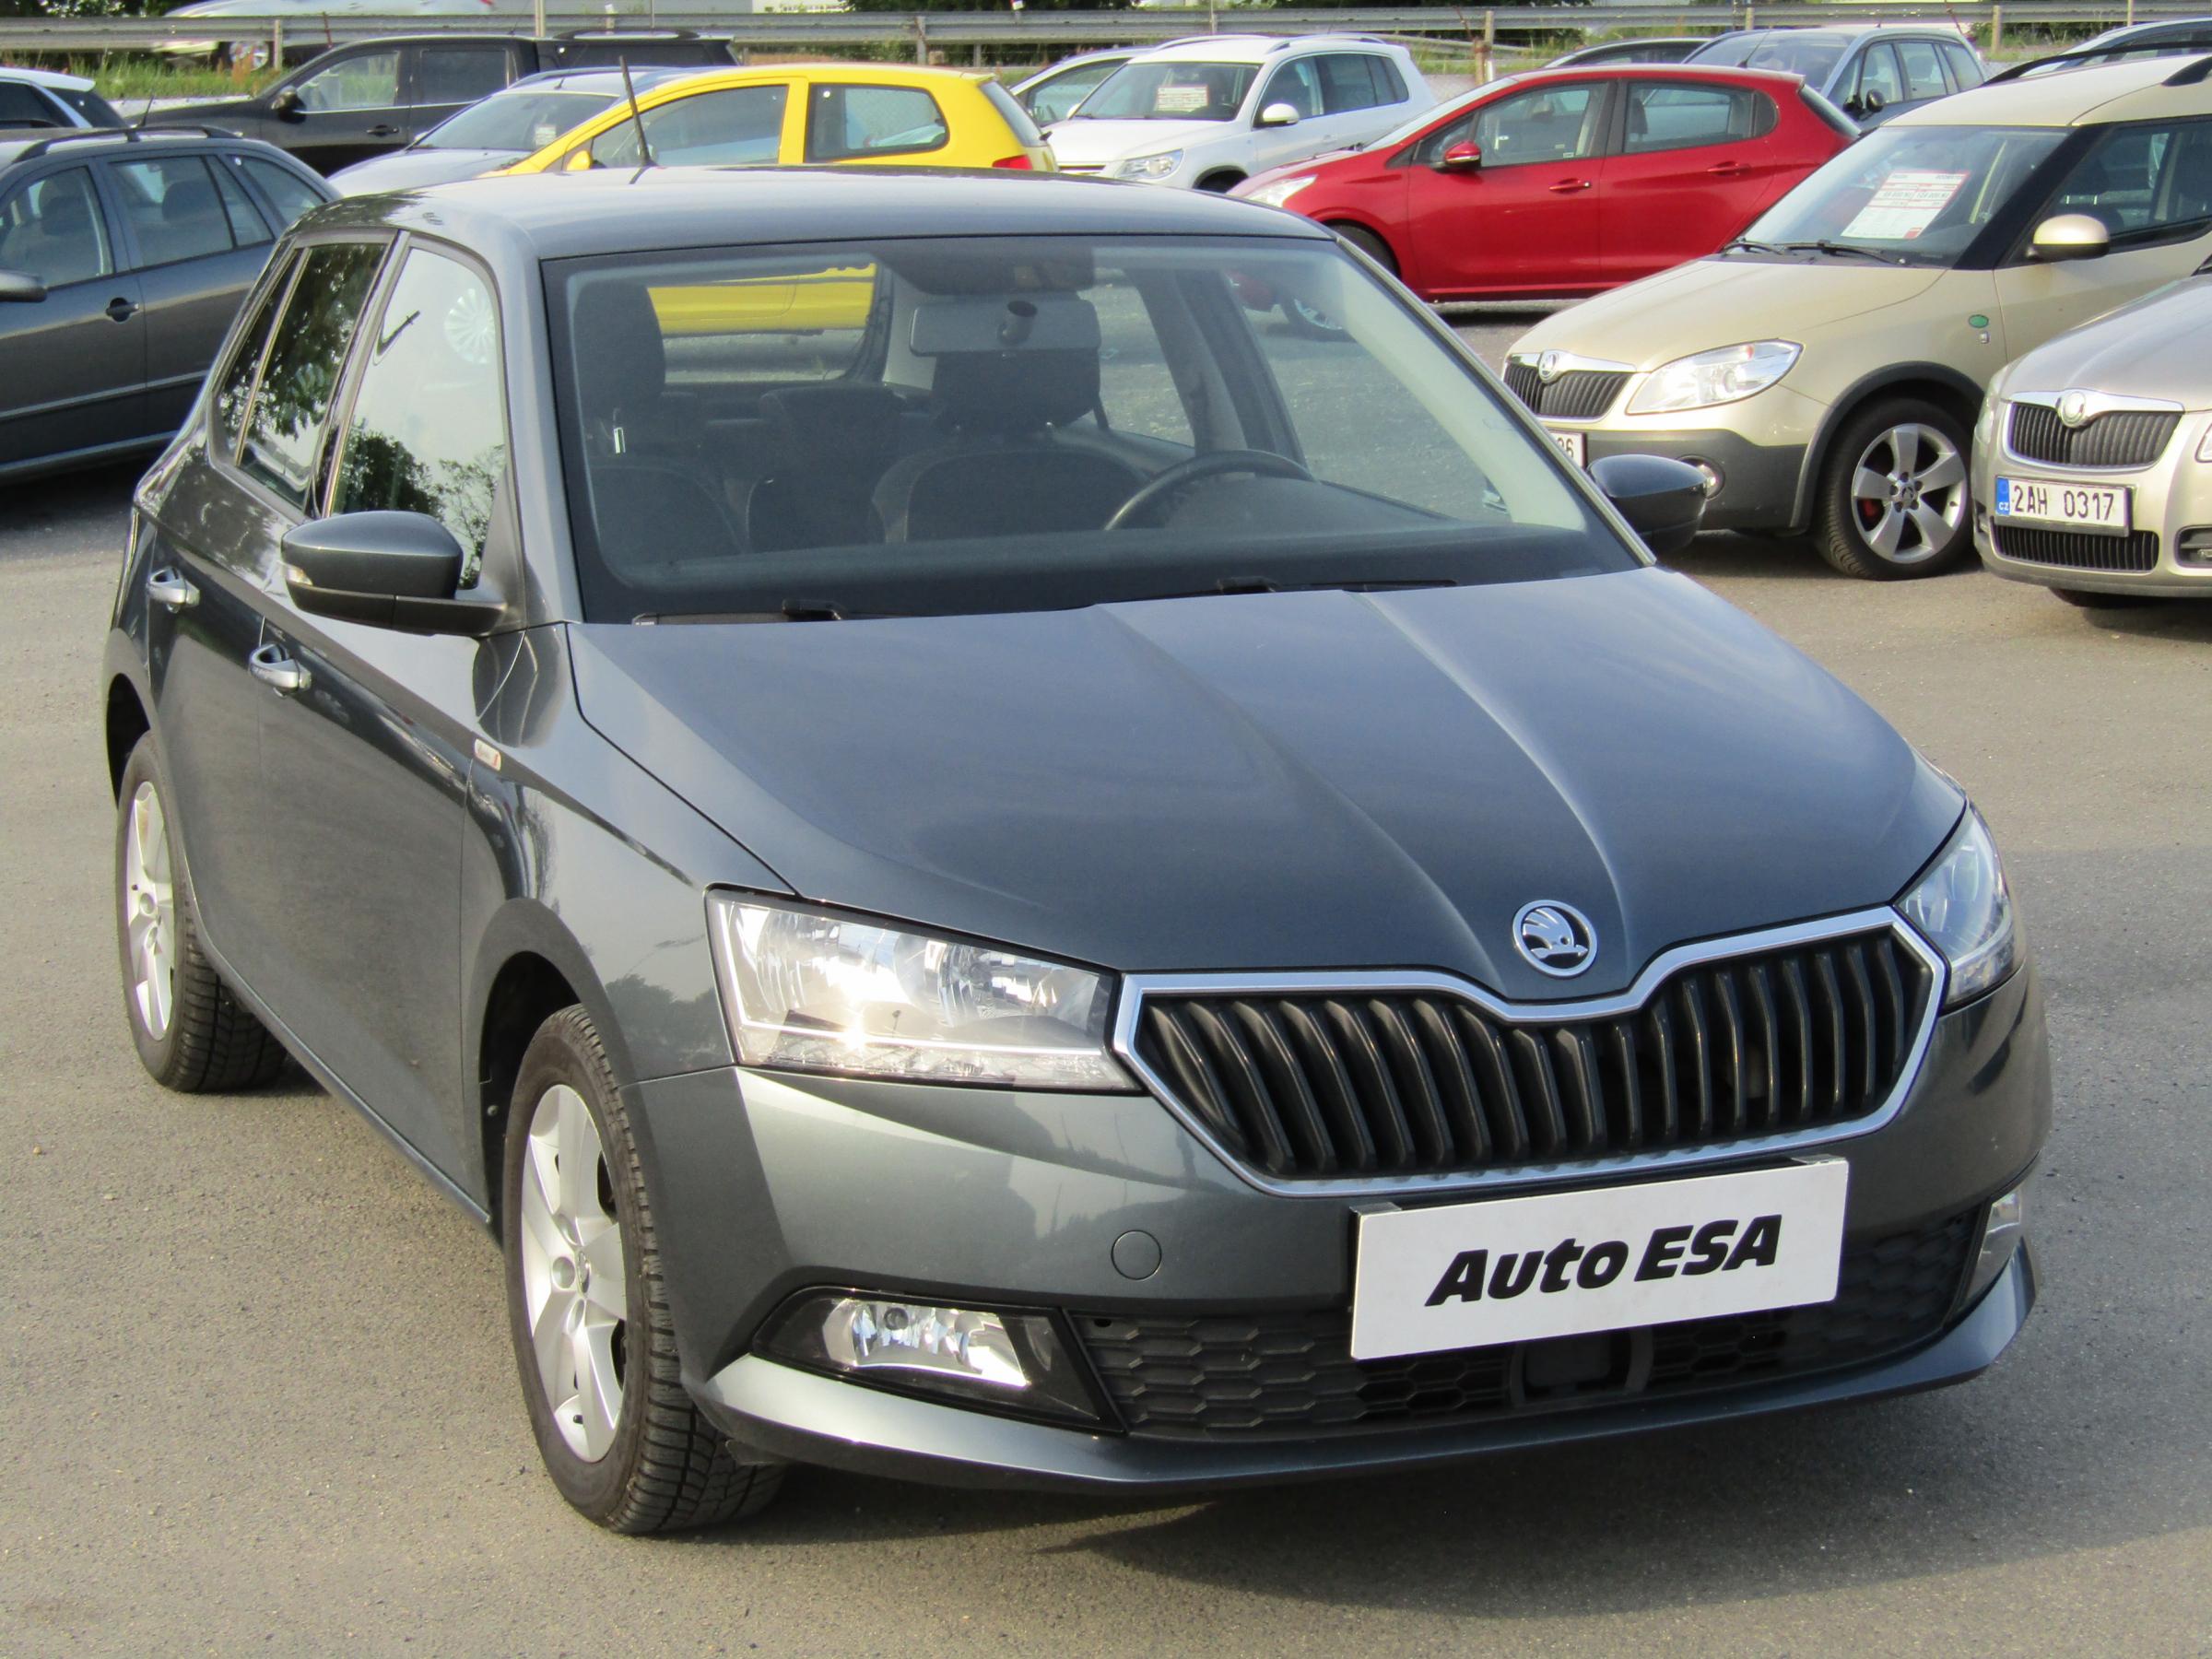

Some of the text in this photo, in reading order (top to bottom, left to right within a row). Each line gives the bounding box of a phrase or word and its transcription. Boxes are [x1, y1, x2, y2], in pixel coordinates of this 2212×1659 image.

[1998, 501, 2009, 512] CZ
[2014, 485, 2114, 521] 2AH 0317
[1424, 1214, 1783, 1307] Auto ESA
